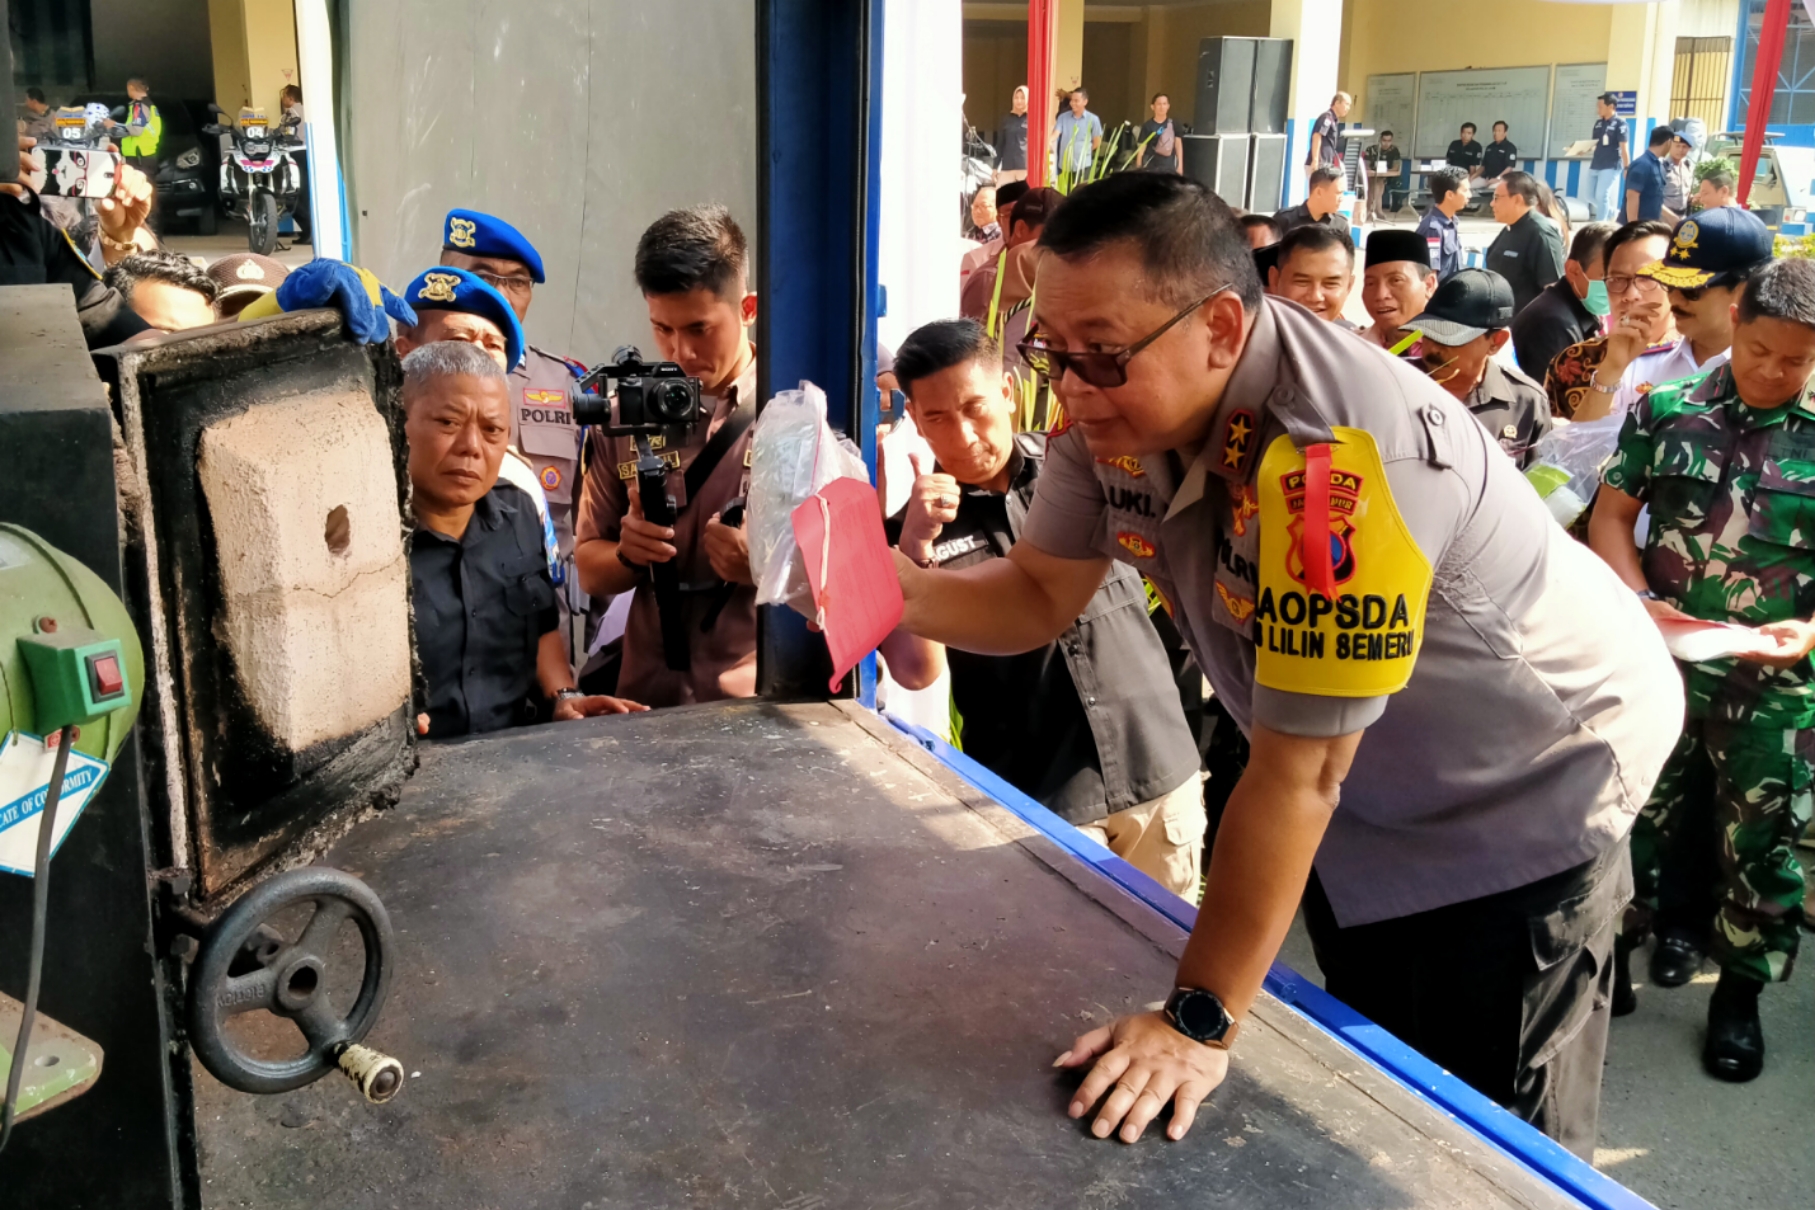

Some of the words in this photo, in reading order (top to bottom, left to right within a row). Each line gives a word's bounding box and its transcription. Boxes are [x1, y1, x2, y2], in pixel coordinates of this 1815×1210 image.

[63, 128, 81, 138] 05
[247, 127, 264, 138] 04
[521, 408, 571, 425] POLRI
[1288, 473, 1356, 490] PDA
[934, 535, 976, 561] GUST
[1269, 625, 1324, 659] LILIN
[21, 797, 33, 814] OF
